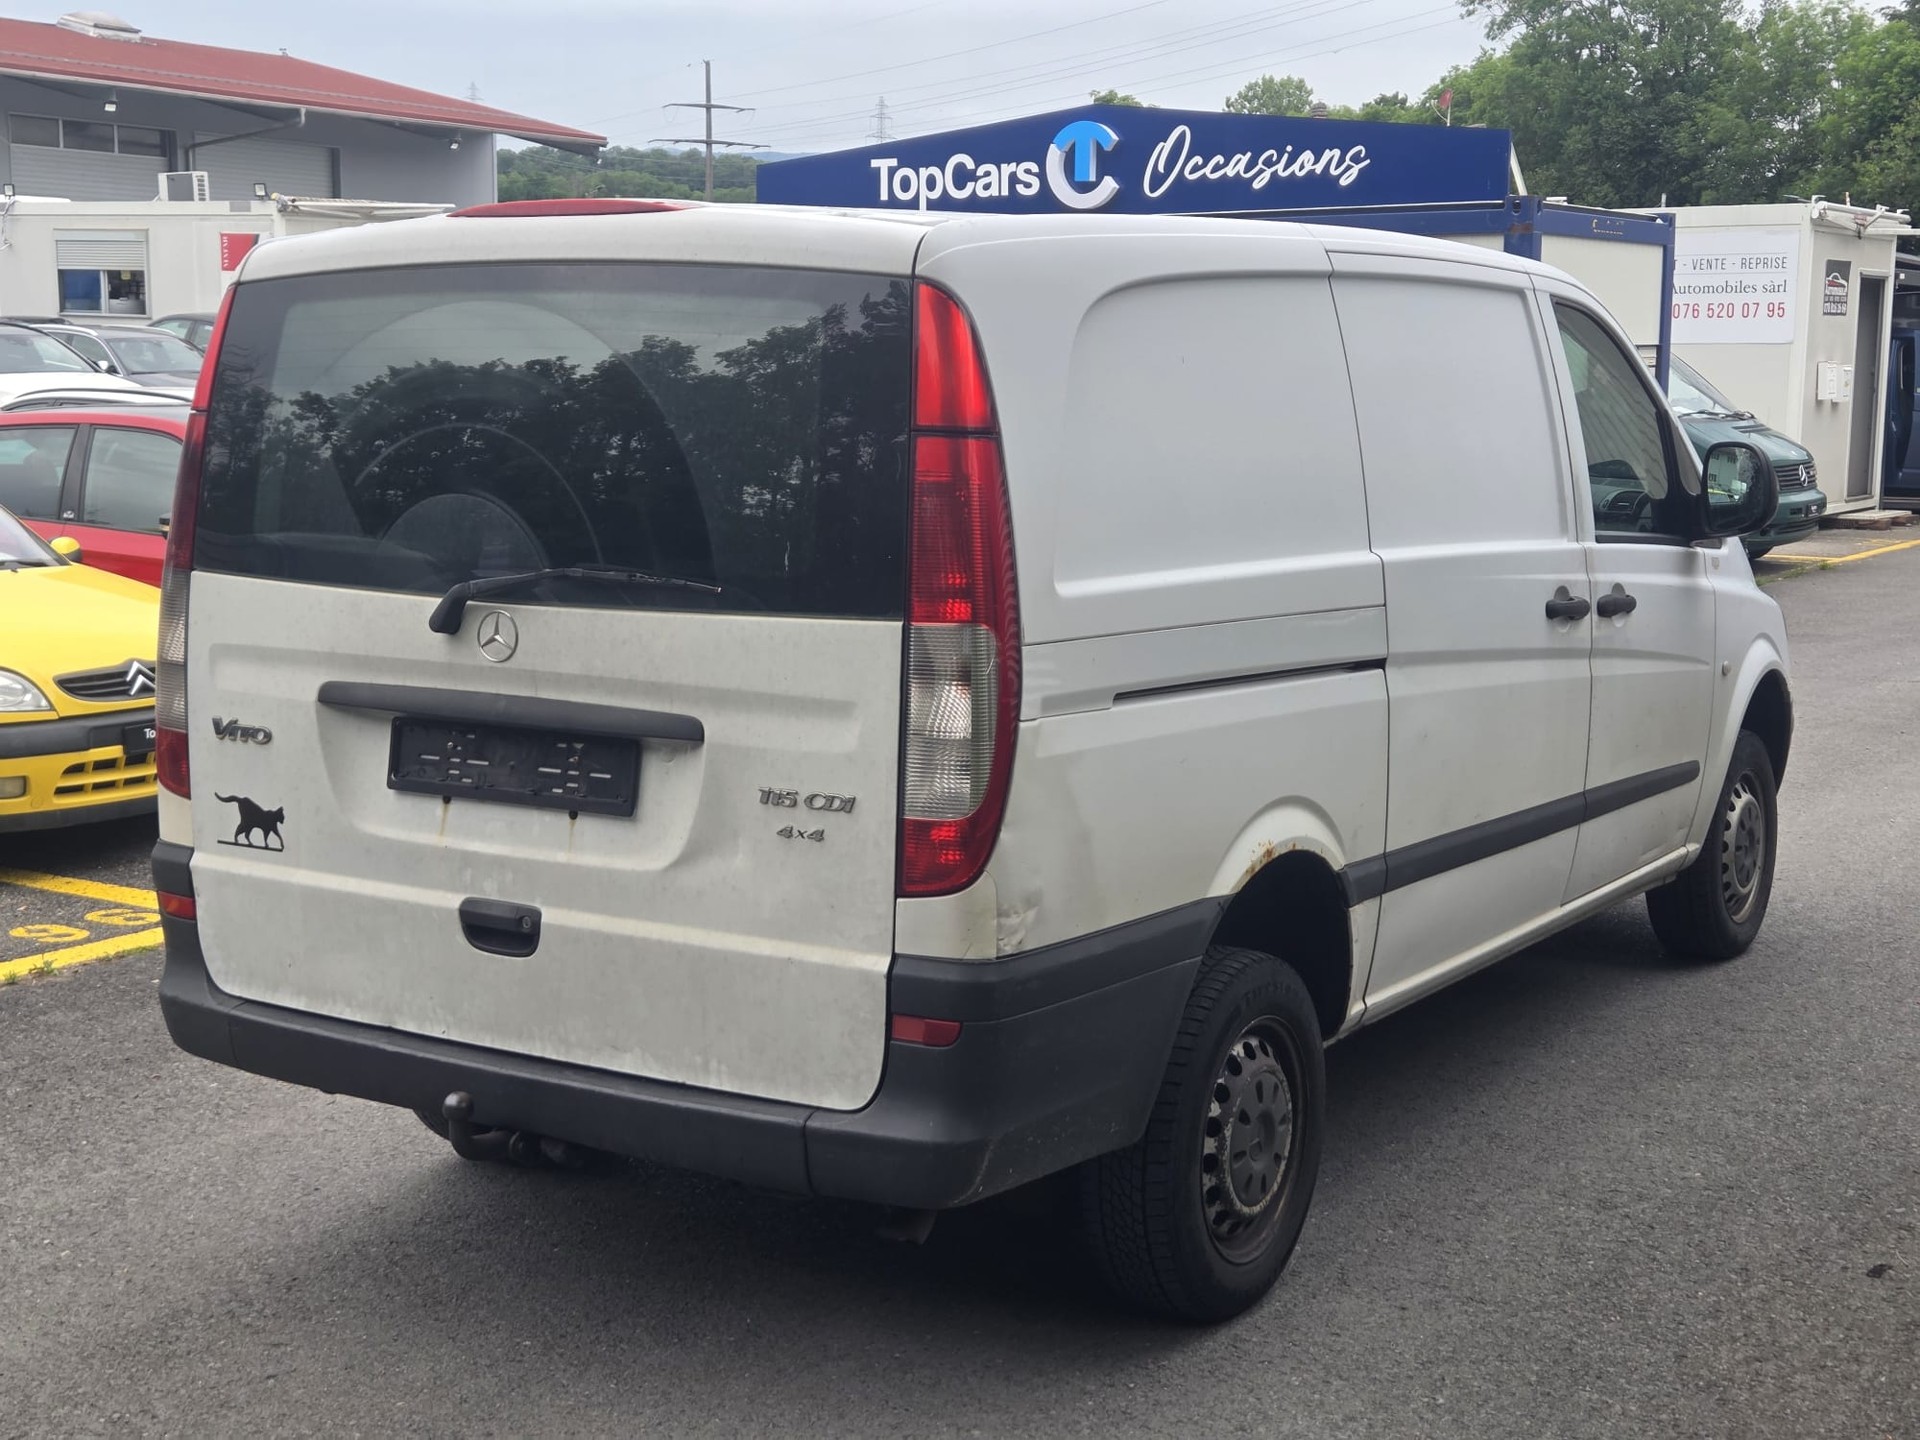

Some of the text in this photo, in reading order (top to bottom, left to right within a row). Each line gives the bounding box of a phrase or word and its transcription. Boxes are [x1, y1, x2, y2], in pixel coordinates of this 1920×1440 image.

[870, 153, 1040, 210] TopCars
[1143, 125, 1371, 197] Occasions
[1692, 258, 1727, 271] VENTE
[1741, 256, 1787, 270] REPRISE
[1673, 302, 1785, 319] 076 520 07 95
[758, 786, 856, 813] 115 CDI
[776, 825, 825, 842] 4x4
